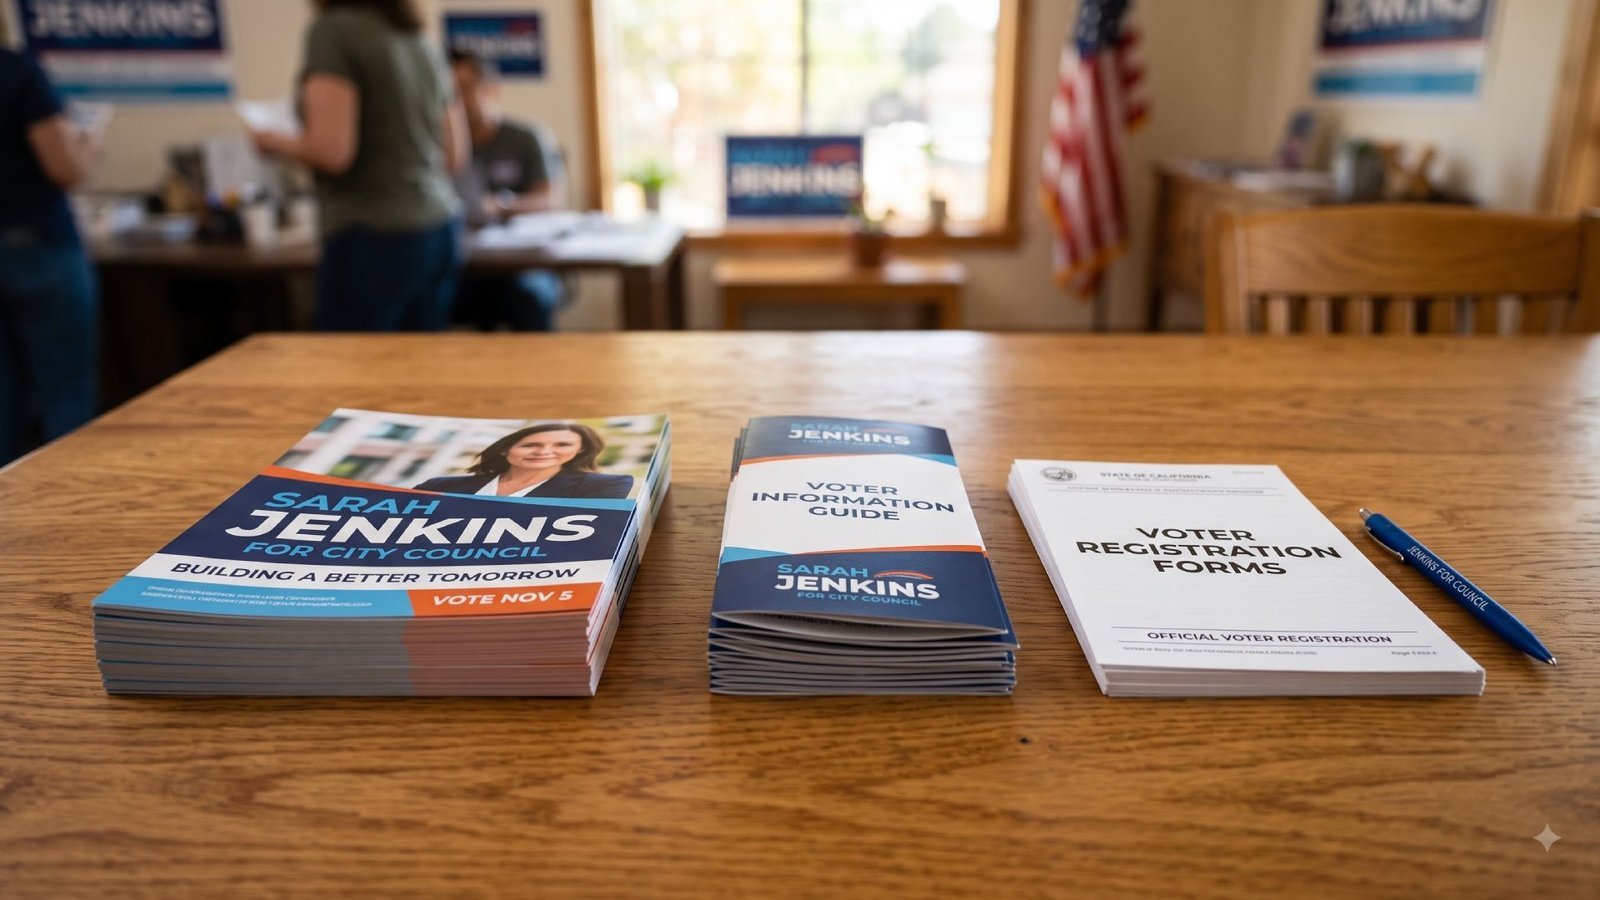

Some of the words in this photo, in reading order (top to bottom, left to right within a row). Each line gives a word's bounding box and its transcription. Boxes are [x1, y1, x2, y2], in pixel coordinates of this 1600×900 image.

[788, 429, 911, 446] JENKINS
[806, 481, 898, 495] VOTER
[264, 491, 441, 515] SARAH
[752, 492, 955, 513] INFORMATION
[808, 506, 900, 521] GUIDE
[224, 509, 599, 545] JENKINS
[1135, 527, 1256, 541] VOTER
[242, 541, 314, 558] FOR
[322, 547, 399, 560] CITY
[403, 546, 548, 560] COUNCIL
[1075, 541, 1342, 558] REGISTRATION
[170, 562, 295, 581] BUILDING
[297, 572, 316, 582] A
[323, 573, 420, 583] BETTER
[427, 568, 581, 583] TOMORROW
[777, 563, 868, 578] SARAH
[1153, 559, 1287, 574] FORMS
[774, 574, 940, 600] JENKINS
[1406, 545, 1440, 571] JENKINS
[1436, 567, 1455, 584] FOR
[1452, 580, 1489, 612] COUNCIL
[432, 593, 496, 606] VOTE
[499, 591, 556, 604] NOV
[558, 590, 574, 601] 5
[828, 593, 858, 601] CITY
[861, 595, 923, 606] COUNCIL
[1147, 632, 1220, 642] OFFICIAL
[1221, 634, 1274, 643] VOTER
[1277, 635, 1393, 643] REGISTRATION
